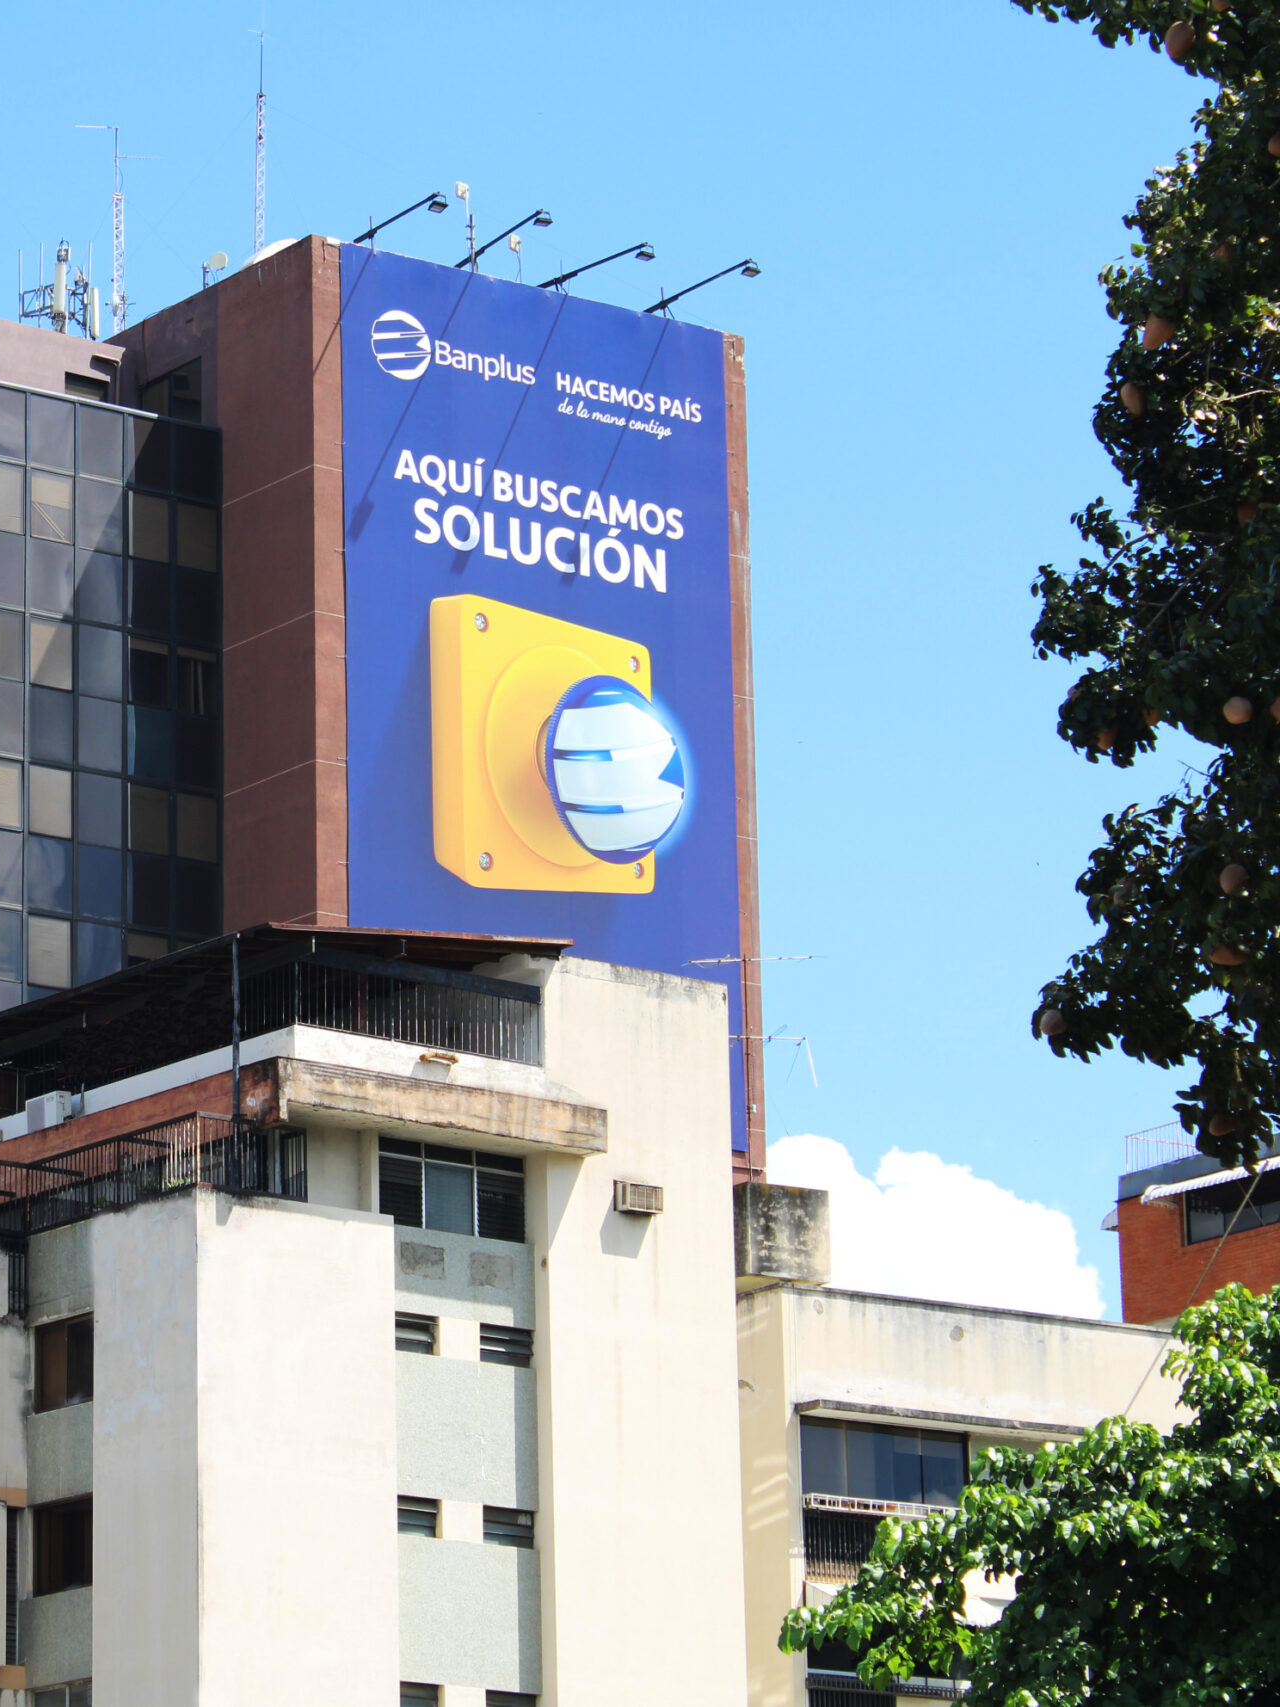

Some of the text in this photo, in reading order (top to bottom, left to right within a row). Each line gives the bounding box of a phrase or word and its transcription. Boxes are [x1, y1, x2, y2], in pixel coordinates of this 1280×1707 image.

[434, 339, 536, 385] Banplus
[555, 371, 703, 423] HACEMOS PAÍS
[557, 397, 673, 441] de la mano contigo
[393, 449, 685, 540] AQUÍ BUSCAMOS
[413, 498, 667, 594] SOLUCIÓN
